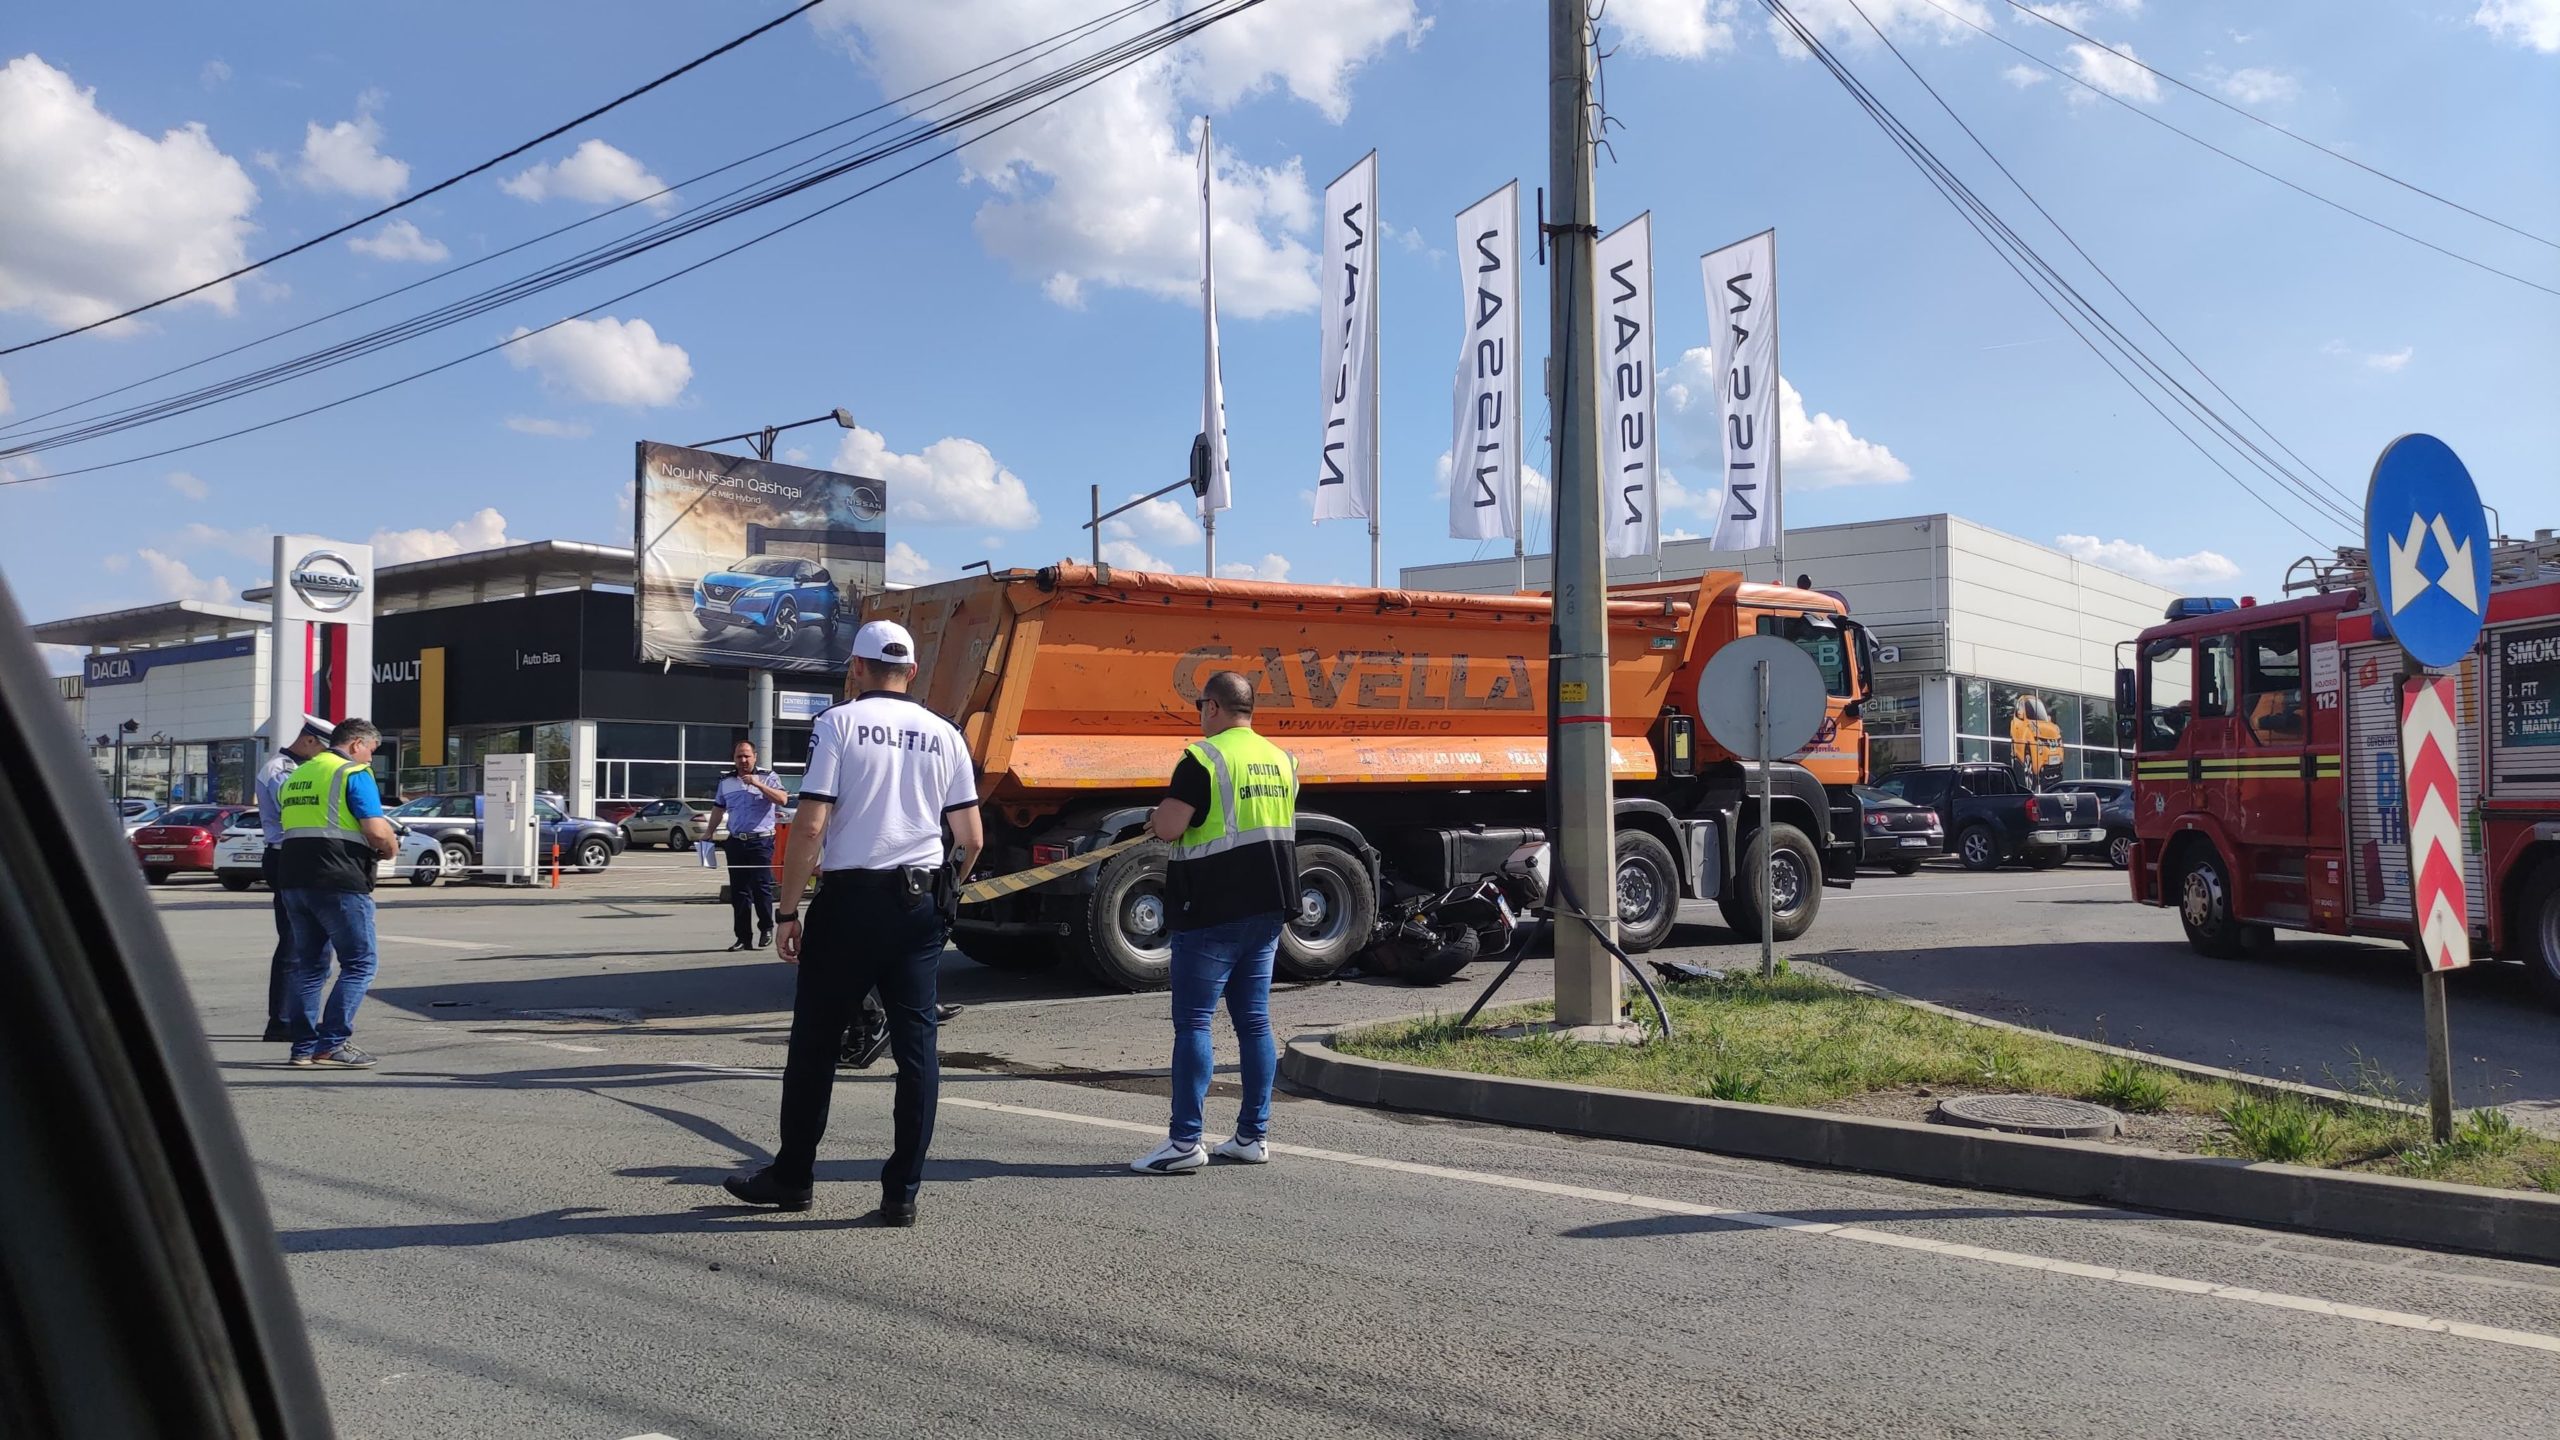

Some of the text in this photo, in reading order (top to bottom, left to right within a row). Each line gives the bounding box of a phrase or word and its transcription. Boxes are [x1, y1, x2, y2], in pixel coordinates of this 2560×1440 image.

[661, 463, 803, 499] Noul Nissan Qashqai
[717, 491, 735, 500] Mild
[735, 493, 761, 504] Hybrid
[847, 498, 882, 510] NISSAN
[300, 574, 359, 588] NISSAN
[522, 652, 561, 665] Auto Bara
[91, 659, 132, 680] DACIA
[371, 660, 422, 683] NAULT
[1172, 645, 1535, 712] GAVELLA
[2521, 682, 2539, 697] FIT
[2316, 692, 2338, 710] 112
[2507, 700, 2551, 717] 2. TEST
[1279, 717, 1452, 733] www.gavella.ro
[2507, 721, 2519, 735] 3.
